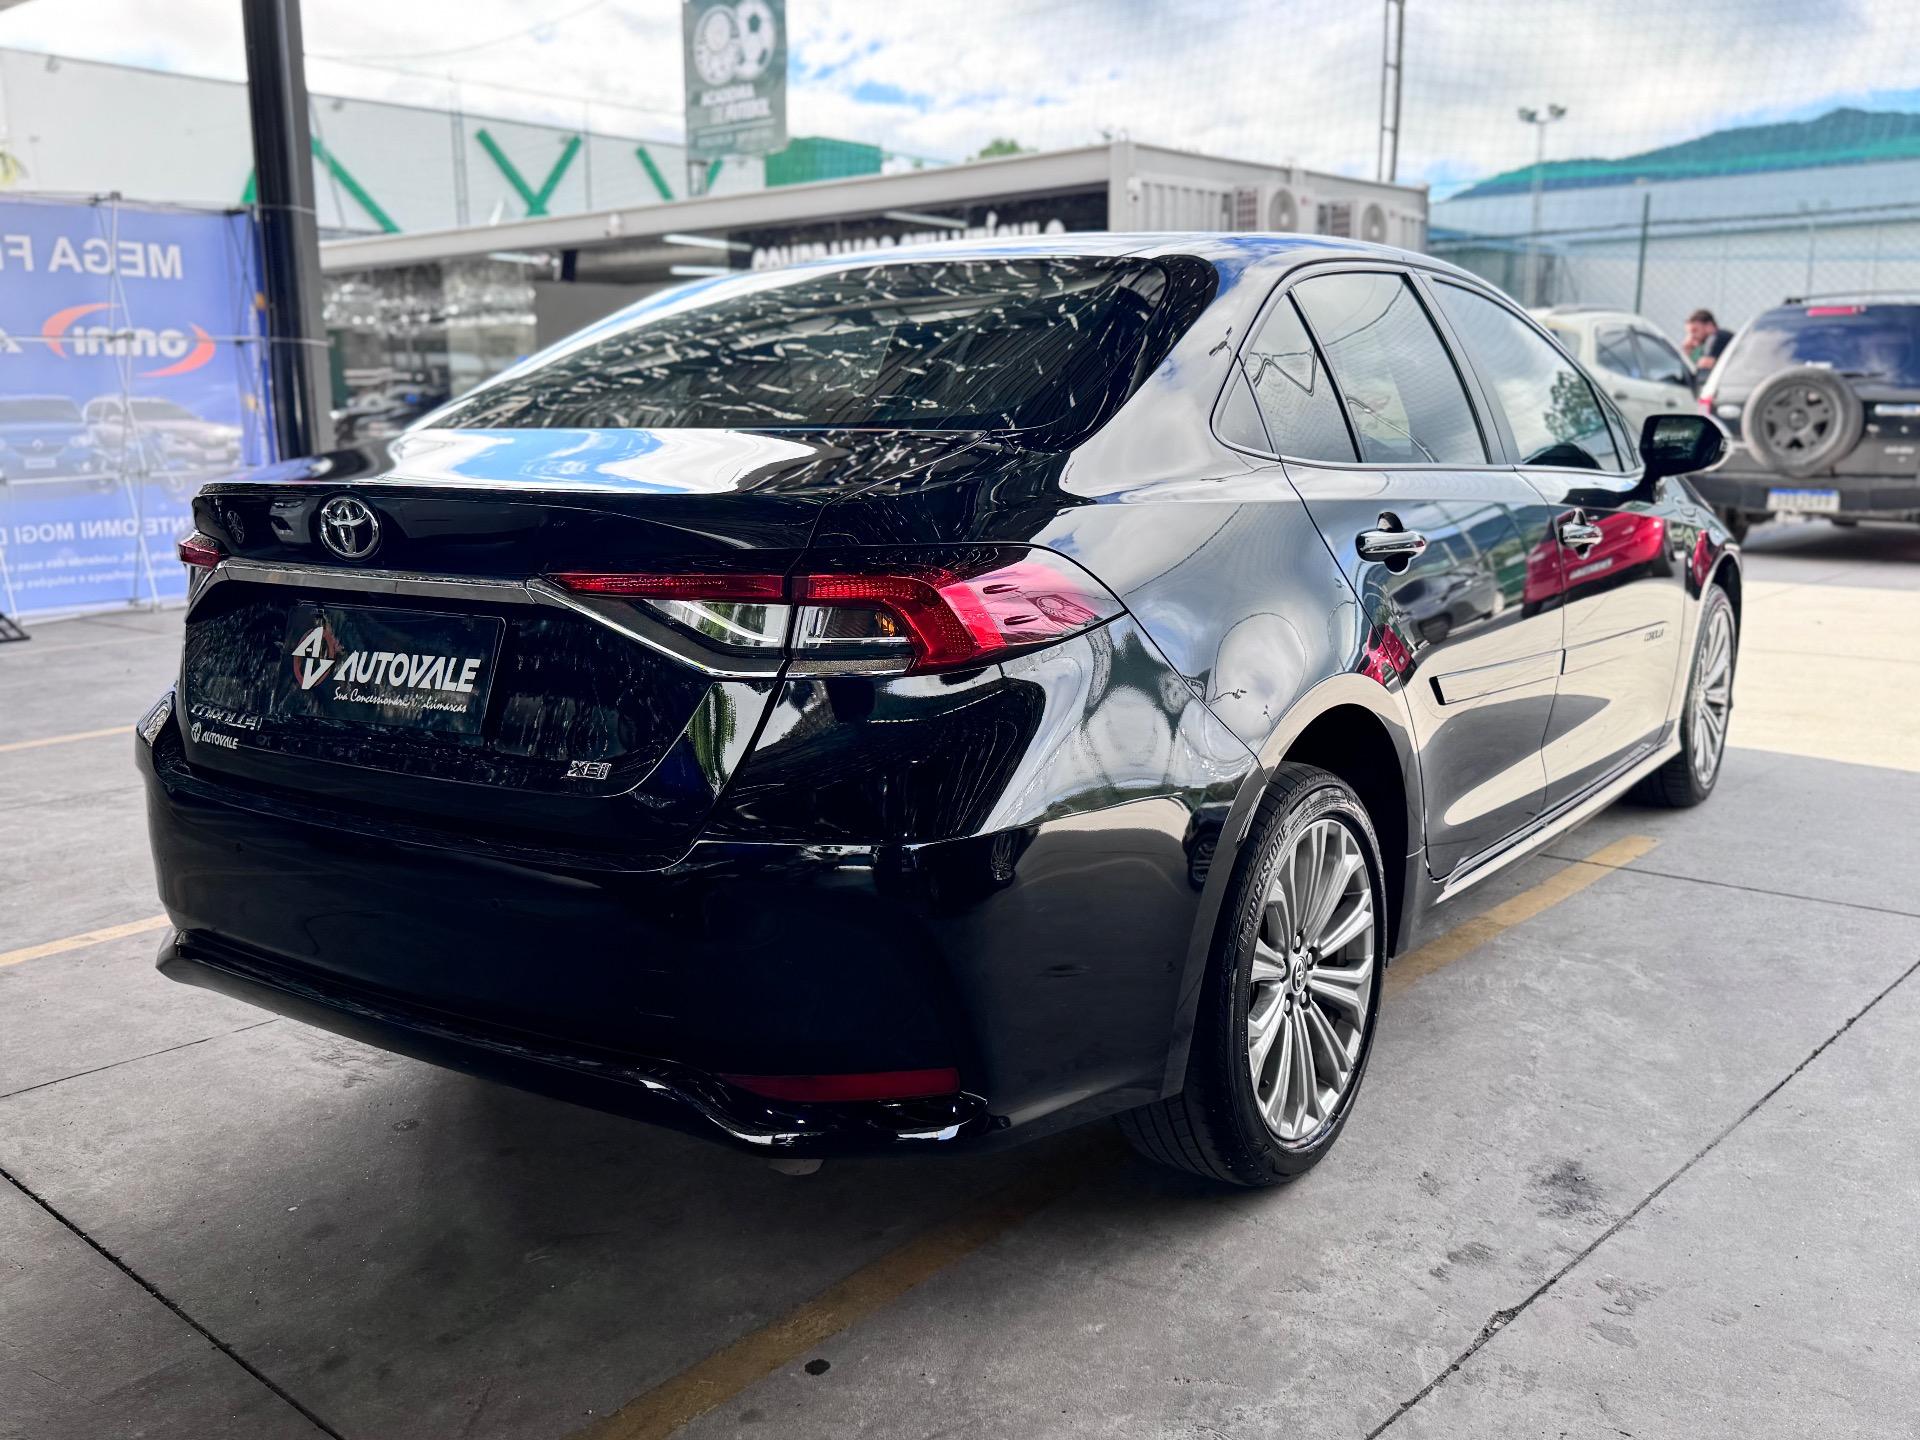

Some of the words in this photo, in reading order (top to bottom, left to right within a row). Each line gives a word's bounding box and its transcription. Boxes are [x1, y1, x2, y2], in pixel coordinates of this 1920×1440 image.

[334, 650, 482, 693] AUTOVALE
[333, 686, 349, 701] Sua
[201, 730, 239, 750] AUTOVALE
[1237, 822, 1289, 953] BRIDGESTONE
